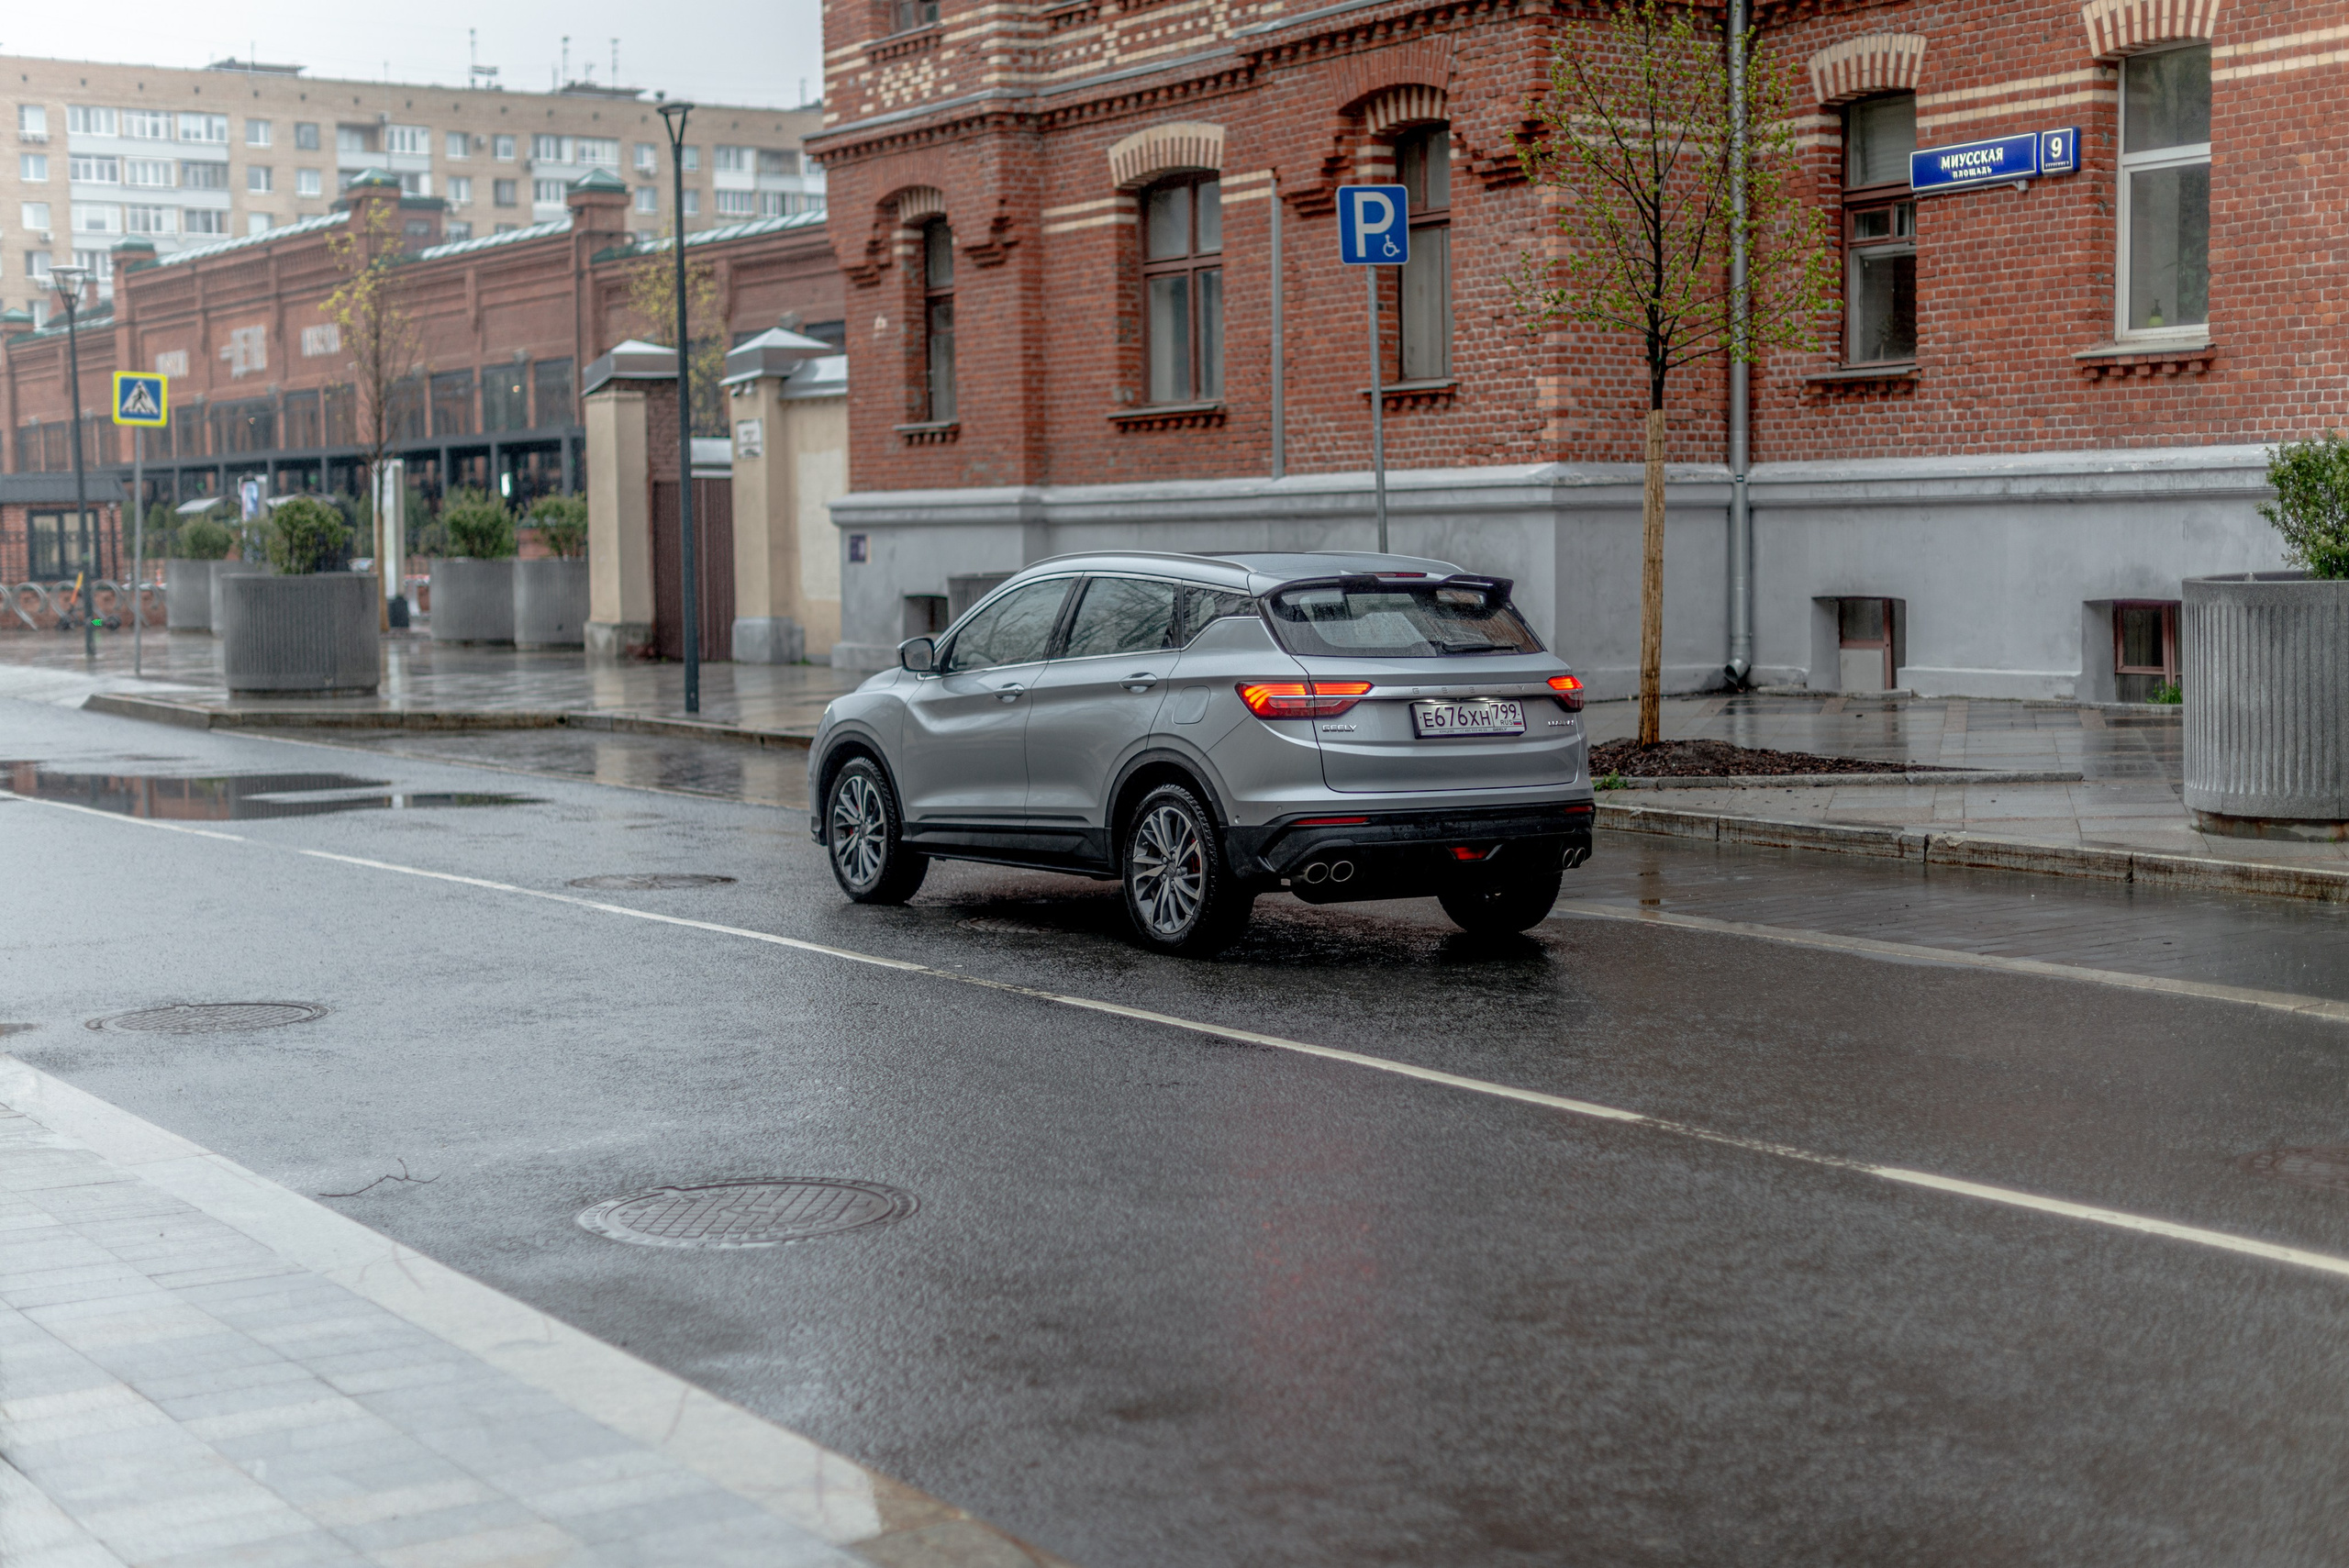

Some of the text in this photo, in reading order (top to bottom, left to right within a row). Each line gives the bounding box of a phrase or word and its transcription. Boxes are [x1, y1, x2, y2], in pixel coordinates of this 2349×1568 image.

[2051, 137, 2063, 158] 9
[1941, 147, 2004, 171] МИУССКАЯ
[1952, 166, 1992, 180] ПЛОЩАДЬ
[1353, 191, 1395, 258] P
[1411, 685, 1525, 695] GEELY
[1422, 704, 1517, 728] Е676ХН 799
[1322, 724, 1357, 732] GEELY
